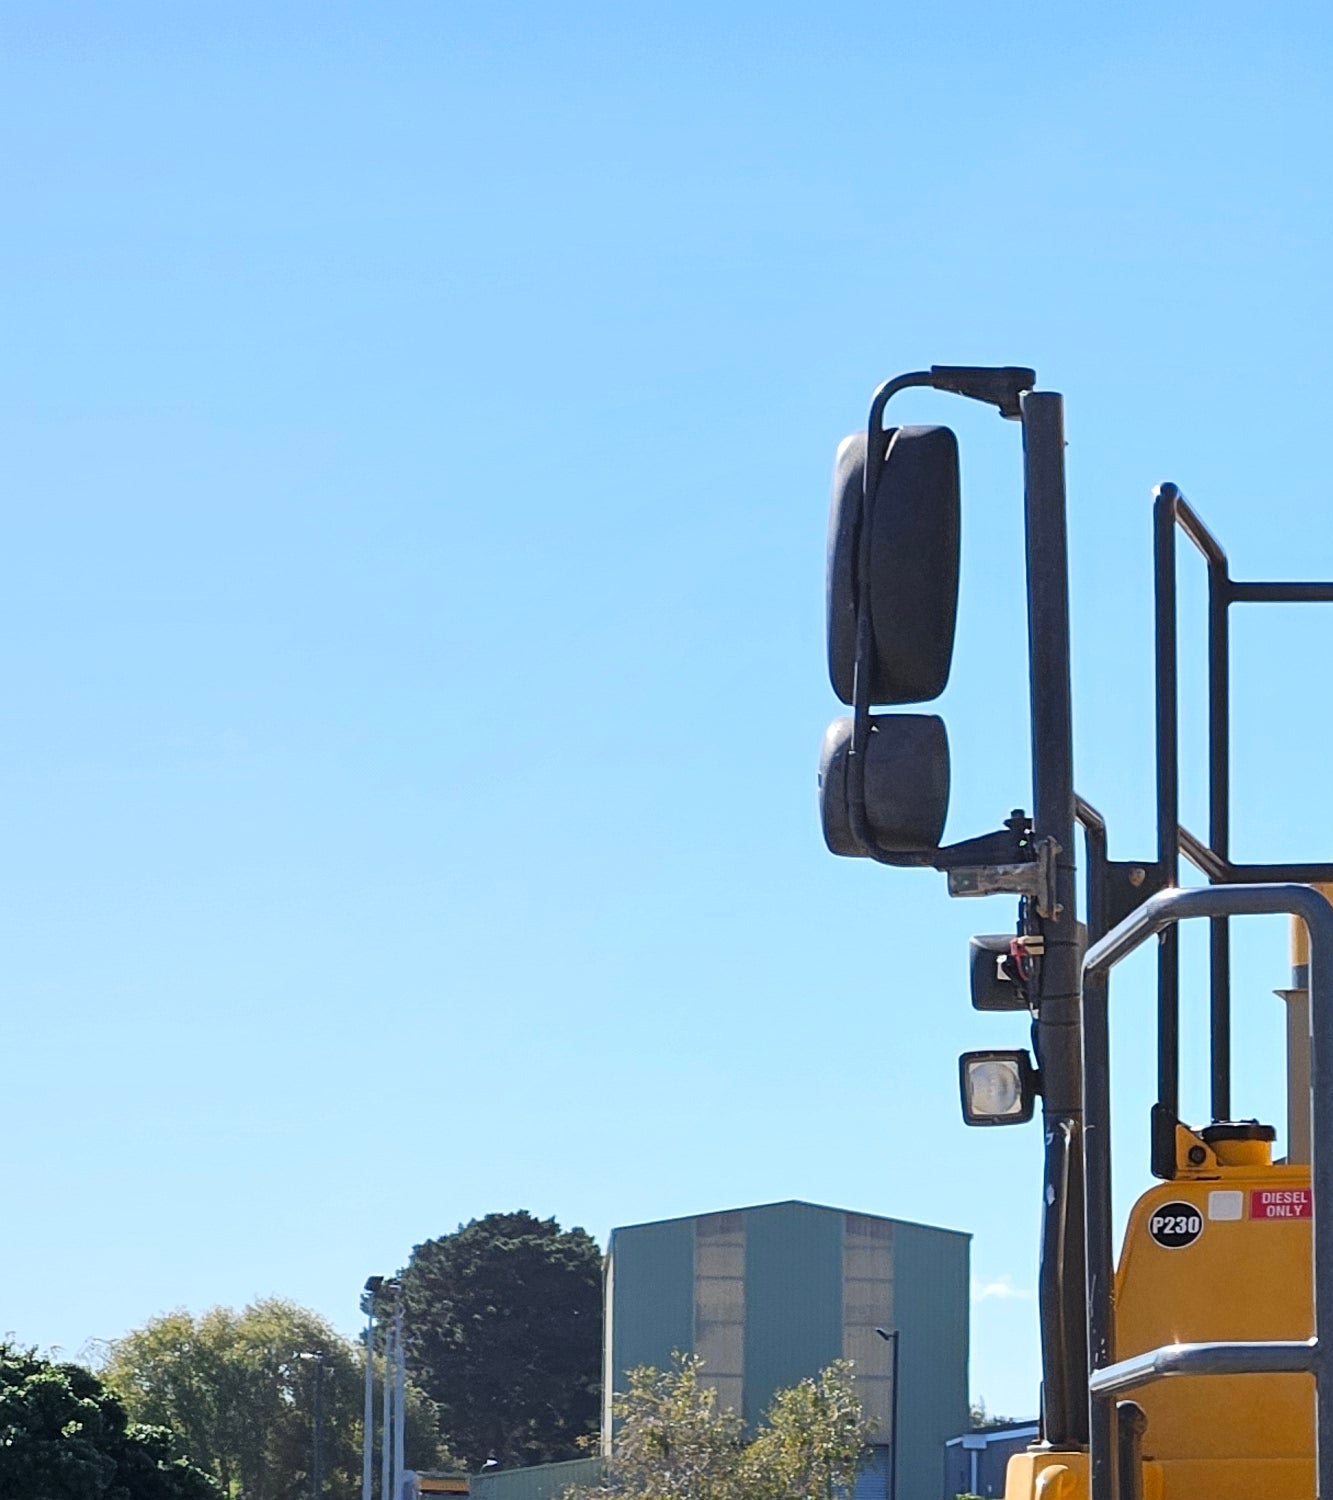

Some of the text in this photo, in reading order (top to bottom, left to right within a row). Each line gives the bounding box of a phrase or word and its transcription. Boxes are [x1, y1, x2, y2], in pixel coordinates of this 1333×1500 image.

[1261, 1191, 1308, 1205] DIESEL
[1266, 1204, 1303, 1217] ONLY
[1151, 1215, 1201, 1235] P230
